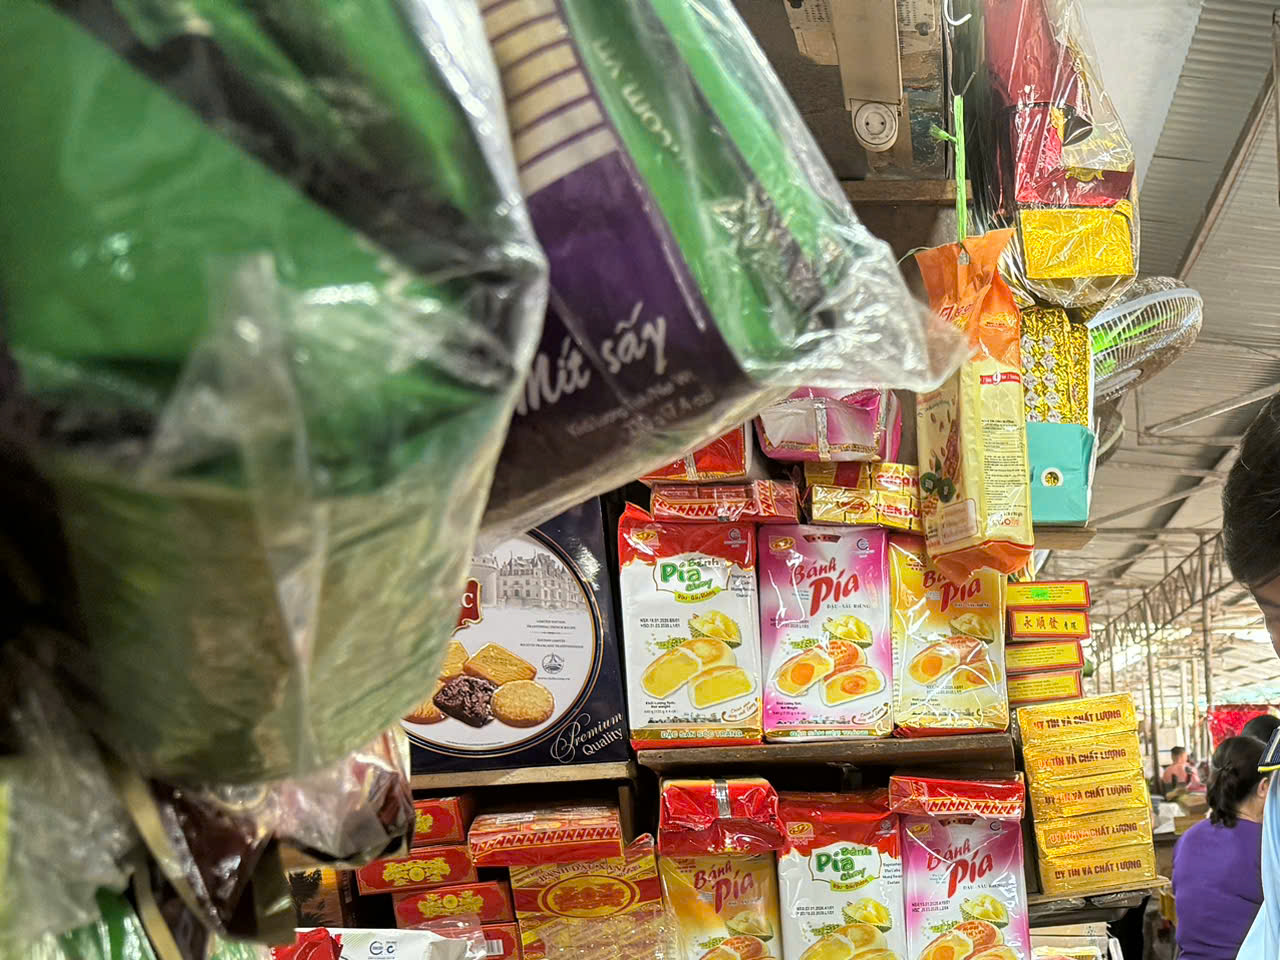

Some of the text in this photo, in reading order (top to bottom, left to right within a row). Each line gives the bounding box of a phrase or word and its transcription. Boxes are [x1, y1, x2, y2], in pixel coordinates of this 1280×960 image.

[516, 336, 592, 416] Mít
[661, 561, 701, 583] Pía
[790, 557, 836, 587] Bánh
[809, 569, 859, 617] Pía
[1095, 709, 1122, 722] LƯỢNG
[551, 713, 624, 764] Premium
[582, 728, 624, 757] Quality
[1051, 755, 1065, 767] TÍN
[1066, 753, 1077, 765] VÀ
[1078, 749, 1099, 763] CHẤT
[1085, 785, 1105, 799] CHẤT
[1106, 784, 1133, 797] LƯỢNG
[1112, 822, 1138, 835] LƯỢNG
[815, 850, 855, 873] Pía
[927, 838, 971, 872] Bánh
[1082, 865, 1093, 876] VÀ
[1094, 860, 1115, 874] CHẤT
[694, 860, 732, 891] Bánh
[945, 849, 994, 899] Pía
[712, 870, 754, 914] Pía
